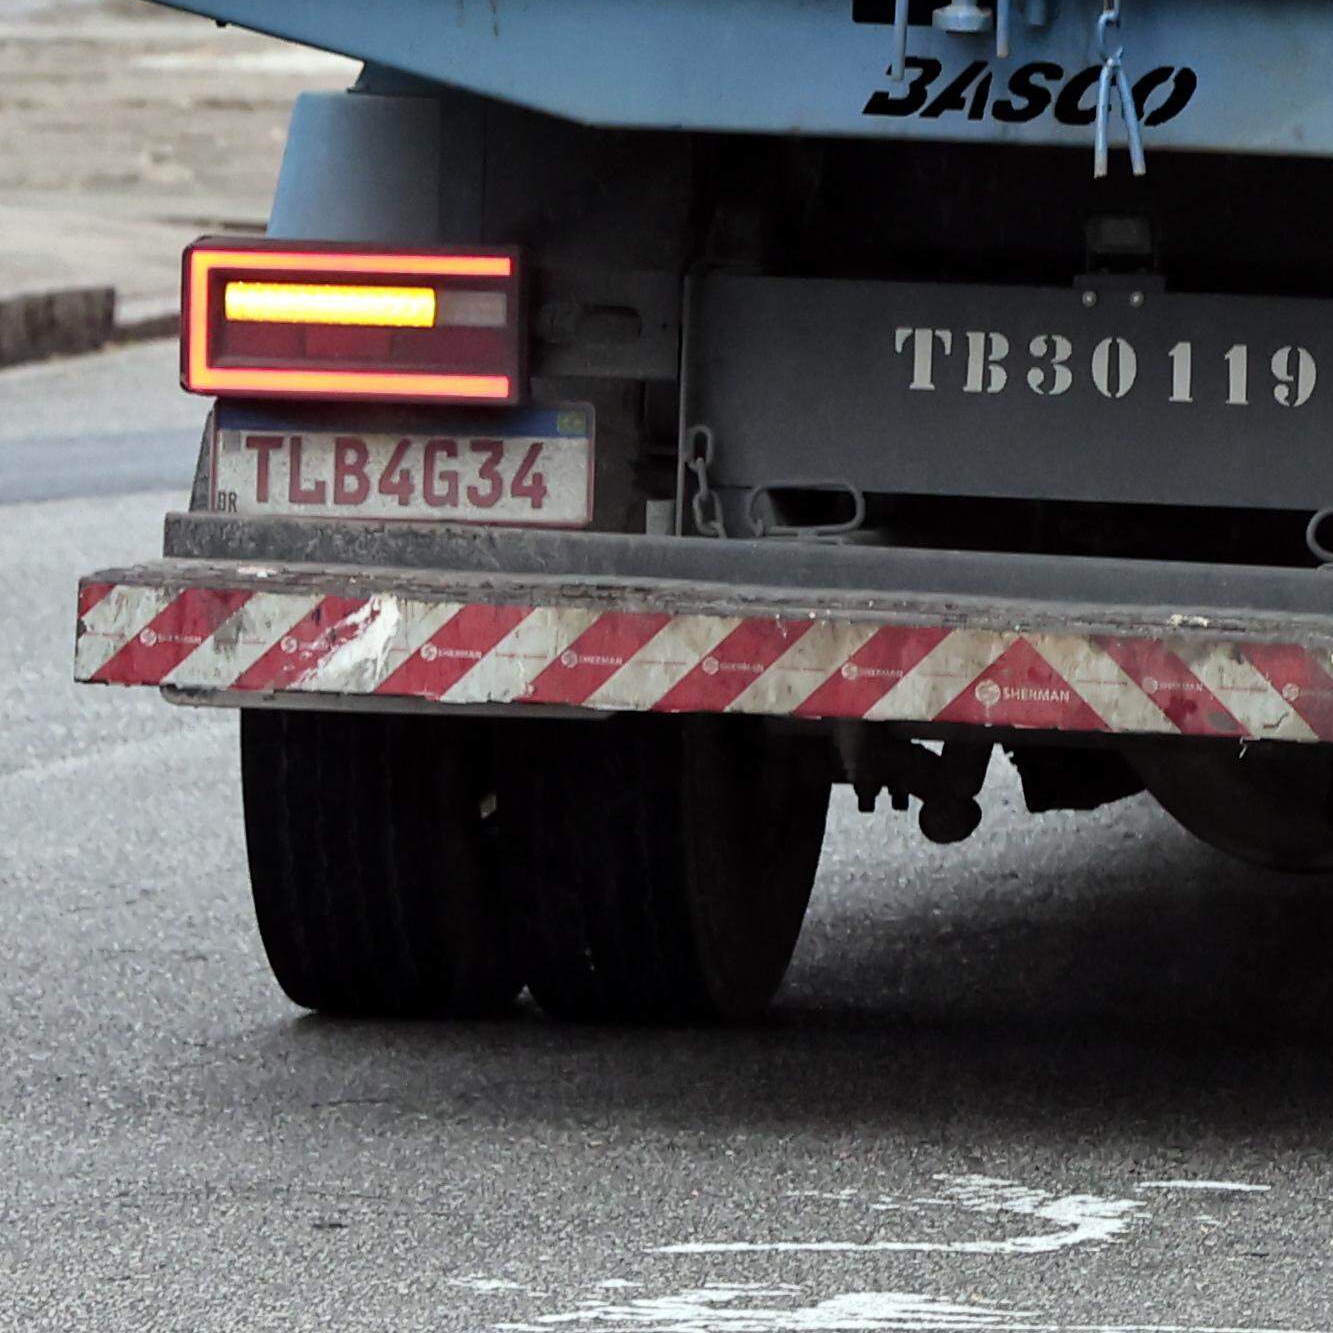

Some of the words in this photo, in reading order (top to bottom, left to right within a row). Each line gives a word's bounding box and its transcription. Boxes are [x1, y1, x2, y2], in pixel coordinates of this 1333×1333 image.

[862, 56, 1197, 126] BASCO
[245, 436, 549, 510] TLB4G34
[1002, 686, 1069, 703] SHERMAN
